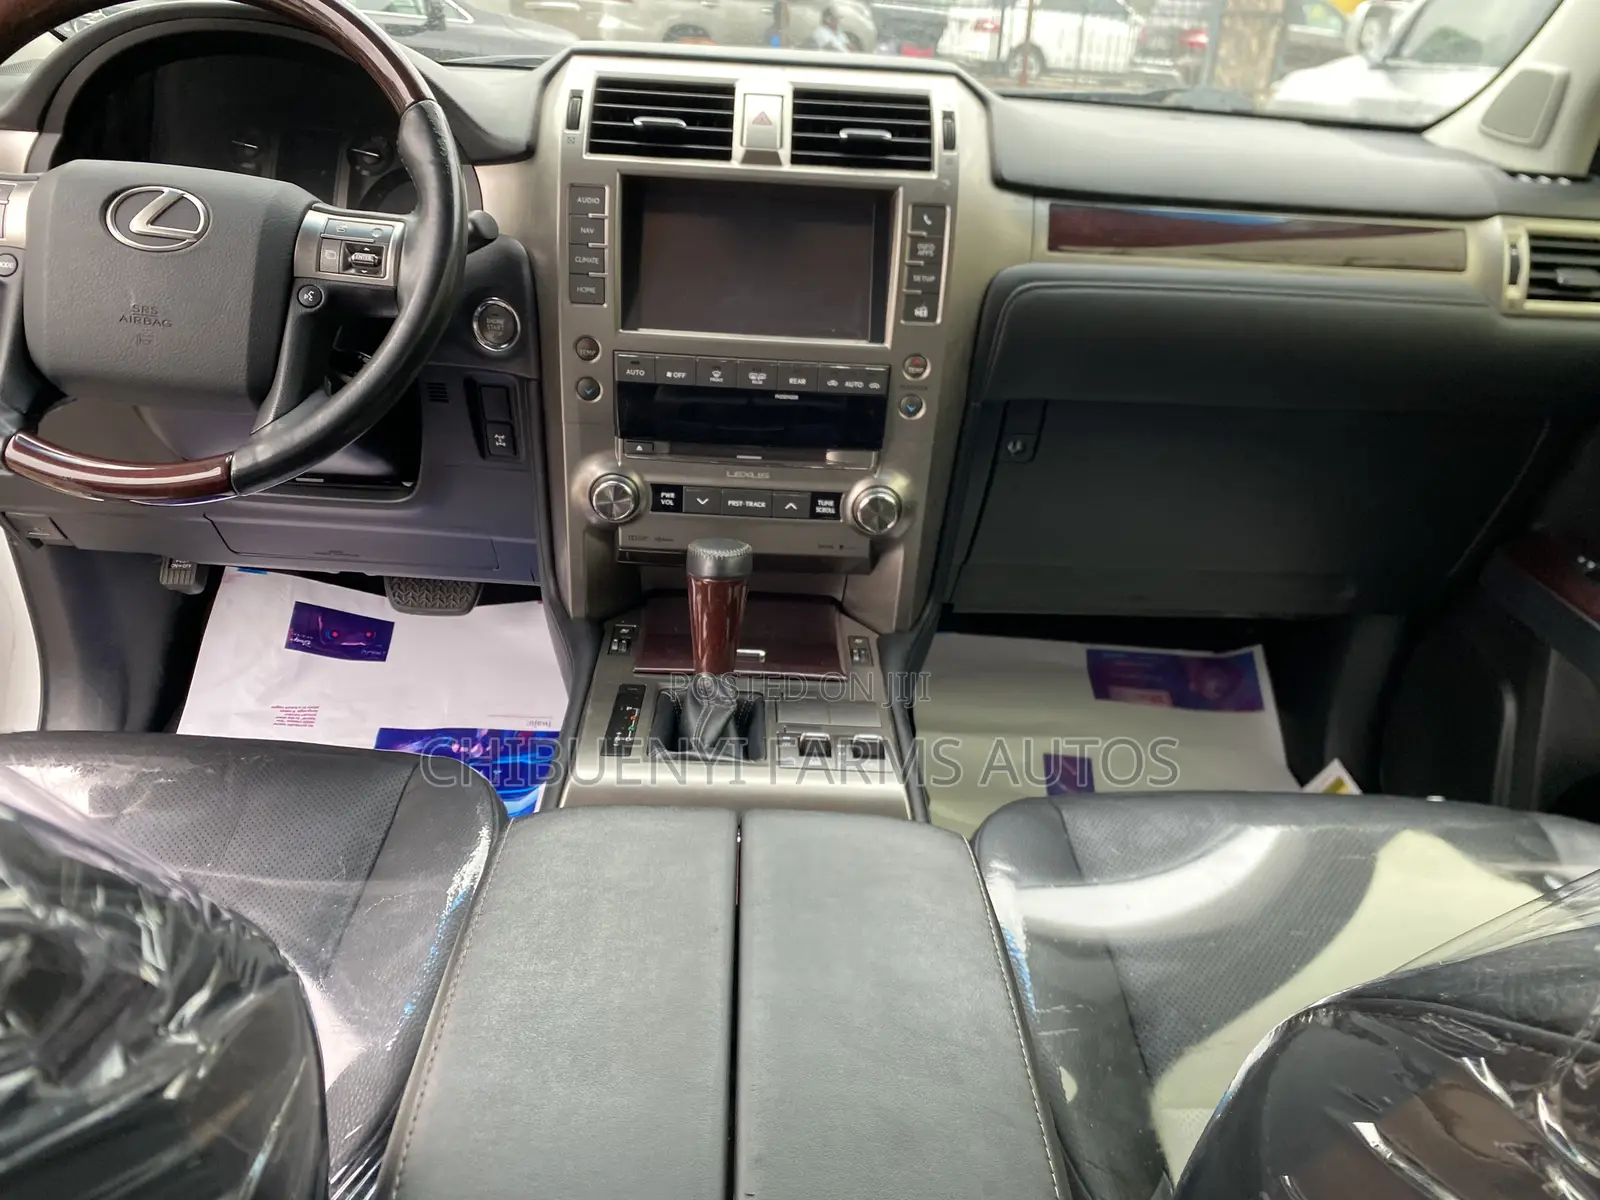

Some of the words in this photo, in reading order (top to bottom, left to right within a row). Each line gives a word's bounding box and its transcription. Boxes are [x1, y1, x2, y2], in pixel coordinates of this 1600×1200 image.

[574, 256, 599, 264] CLIMATE
[576, 286, 596, 294] HOME
[132, 304, 159, 315] SRS
[119, 314, 172, 328] AIRBAG
[673, 371, 686, 379] OFF
[726, 470, 770, 478] LEXUS
[815, 506, 836, 514] SCROLL
